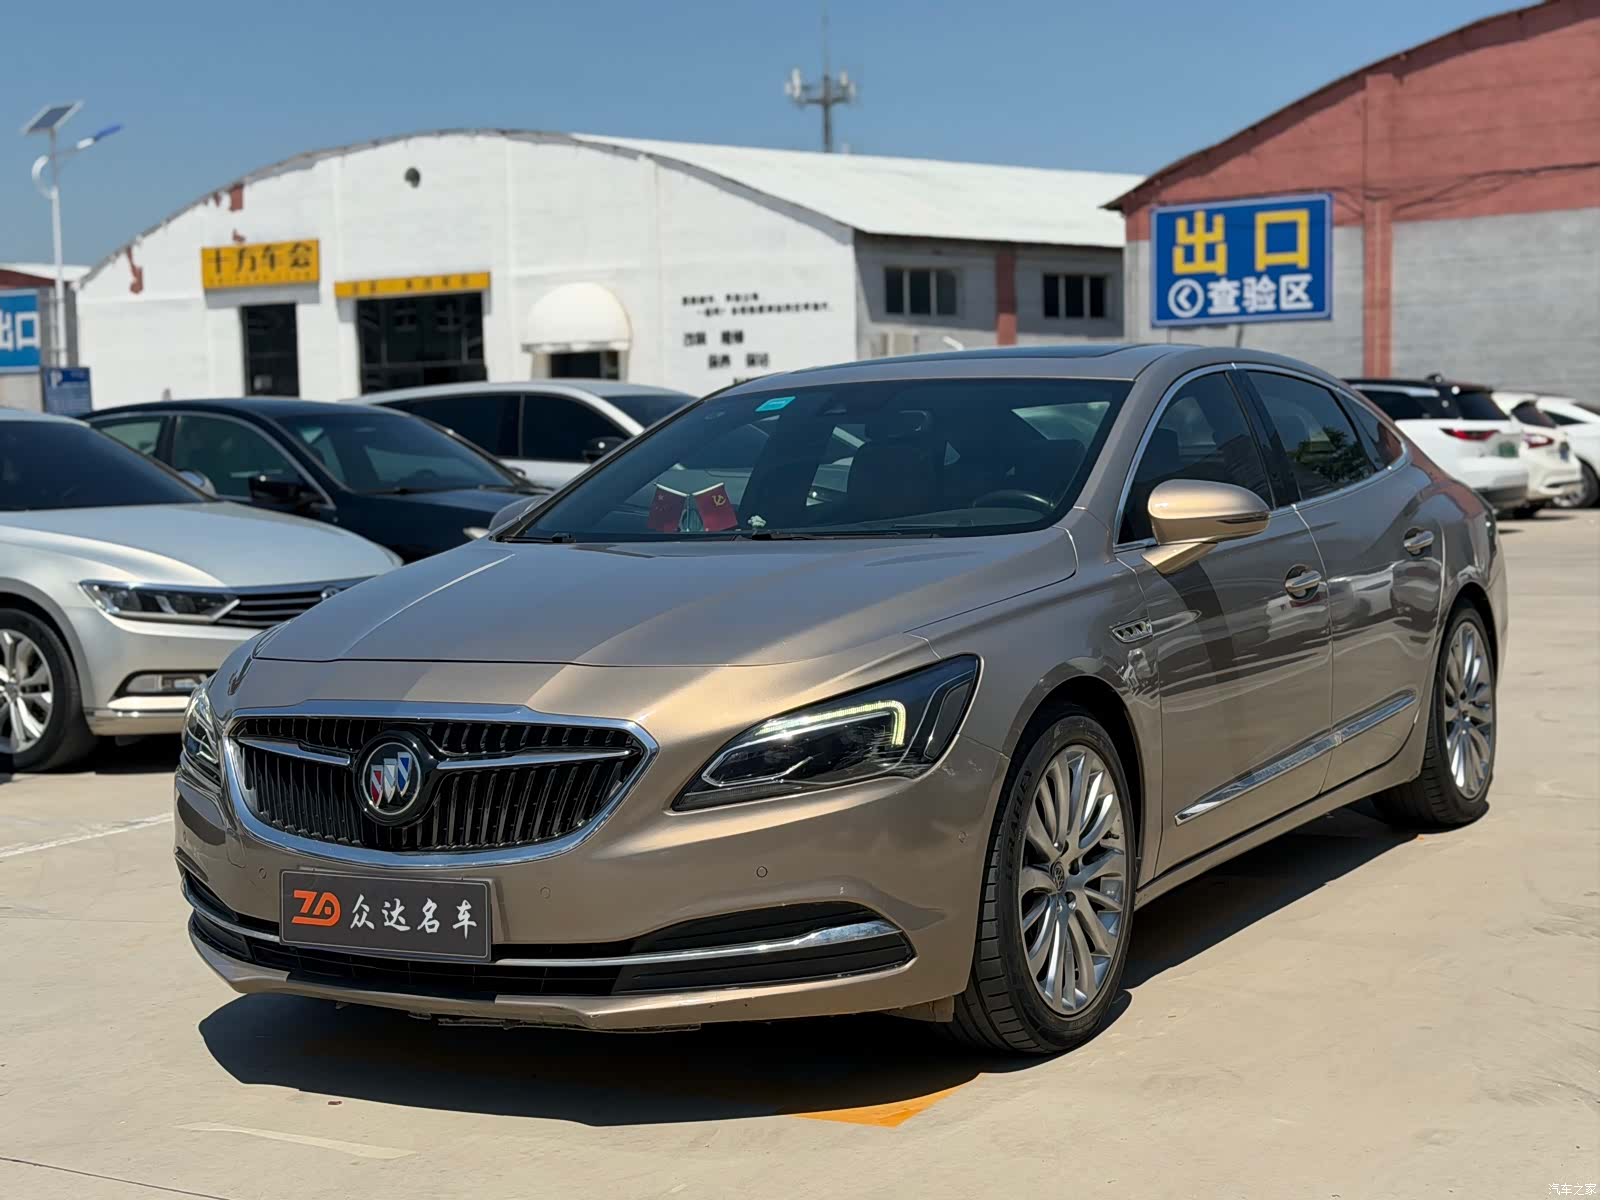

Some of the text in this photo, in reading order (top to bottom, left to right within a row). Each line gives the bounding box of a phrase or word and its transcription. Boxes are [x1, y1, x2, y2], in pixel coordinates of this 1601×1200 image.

[1173, 210, 1310, 275] 出口
[1207, 274, 1313, 315] 查验区
[350, 894, 478, 940] 众达名车
